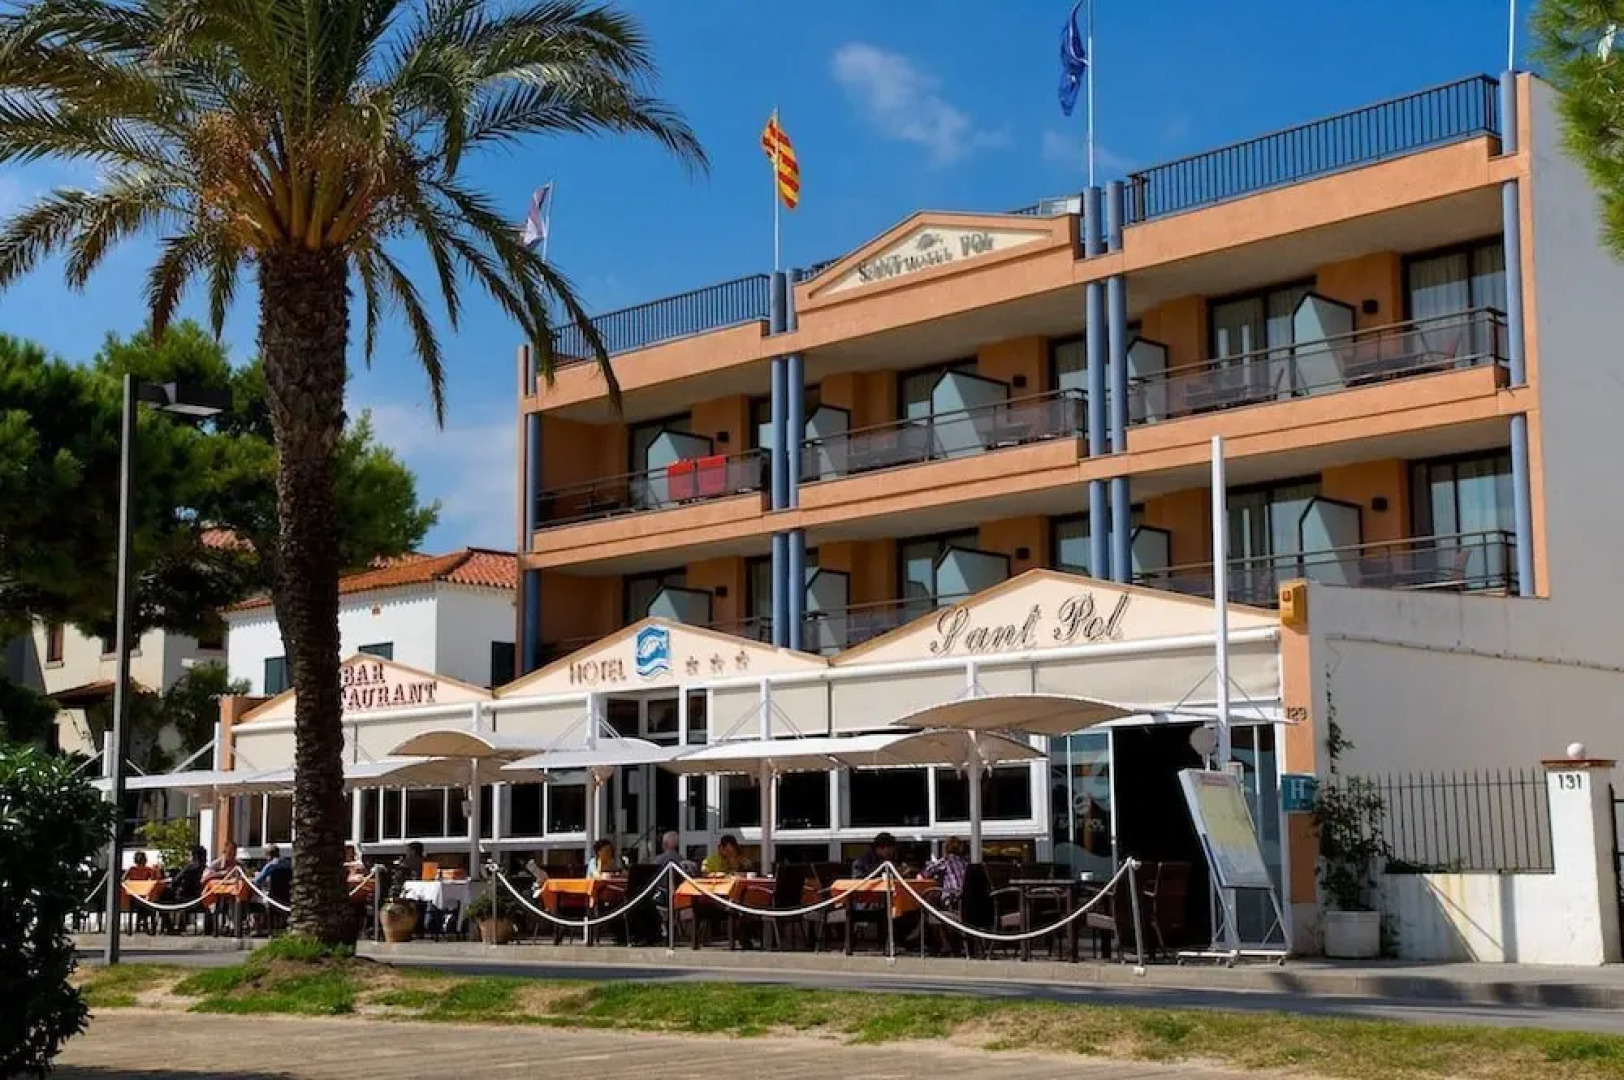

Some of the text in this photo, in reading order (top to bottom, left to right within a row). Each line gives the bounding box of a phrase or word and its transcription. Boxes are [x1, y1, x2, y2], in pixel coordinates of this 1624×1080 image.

[929, 590, 1131, 654] Sant Pol
[343, 663, 386, 686] BAR
[569, 657, 627, 686] HOTEL
[1290, 779, 1305, 800] H
[1558, 773, 1582, 790] 131
